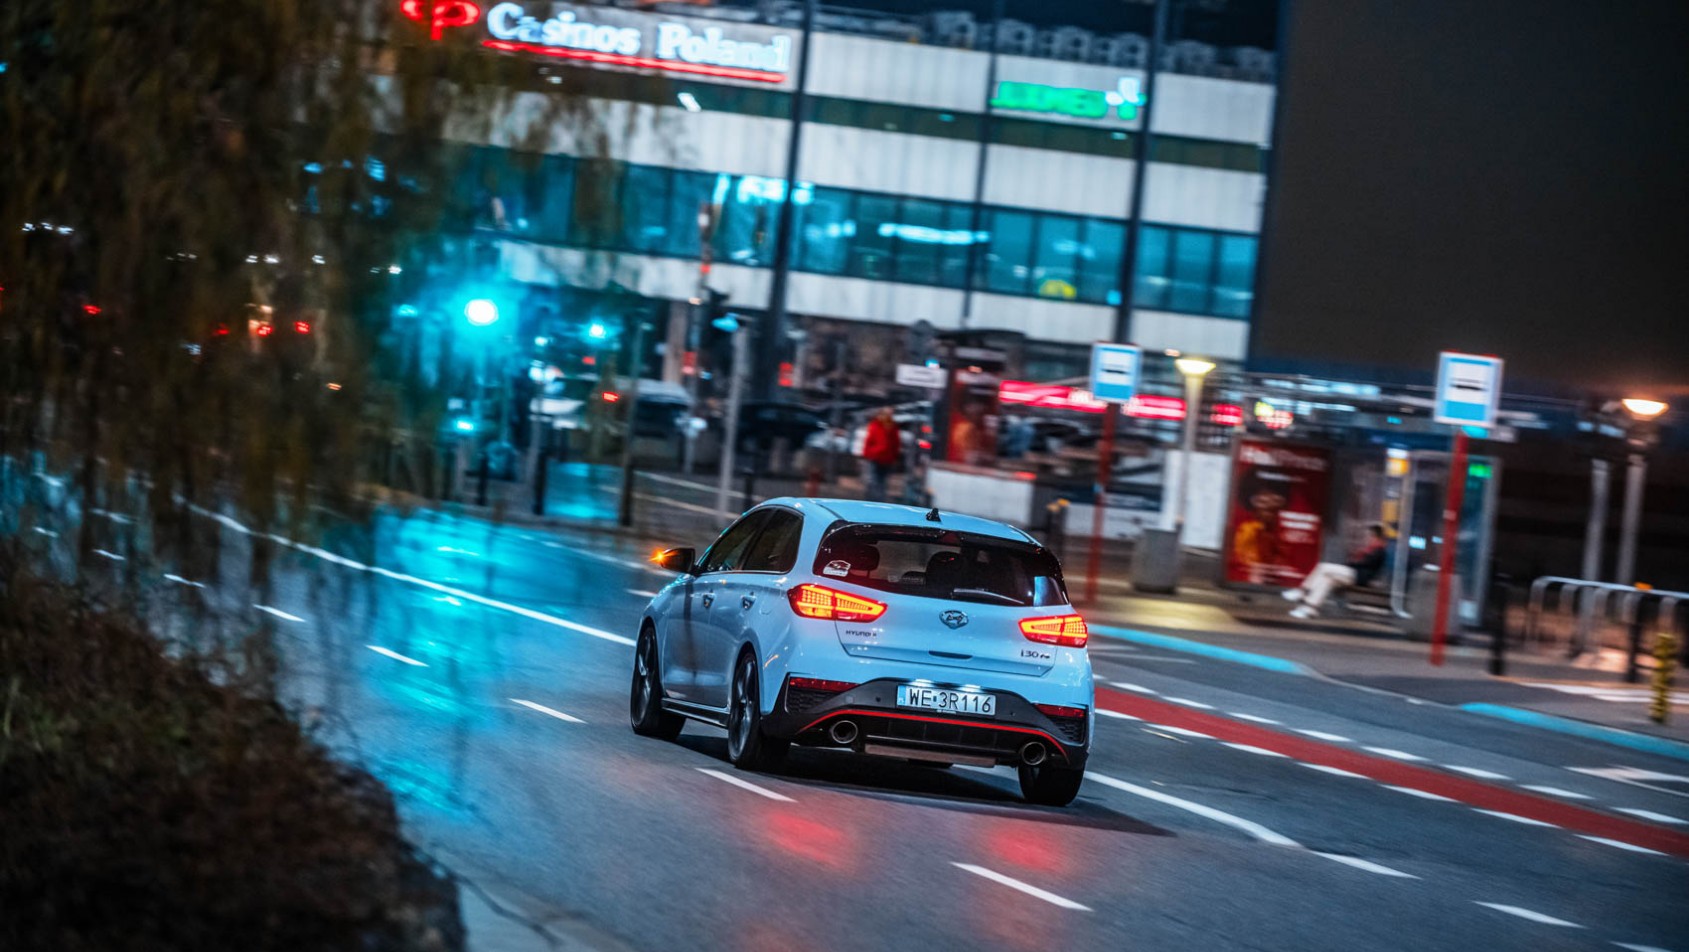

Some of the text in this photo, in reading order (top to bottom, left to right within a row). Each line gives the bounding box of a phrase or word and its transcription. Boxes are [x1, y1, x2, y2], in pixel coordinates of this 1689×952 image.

[487, 2, 791, 72] Casinos Poland
[909, 688, 991, 713] WE 3R116
